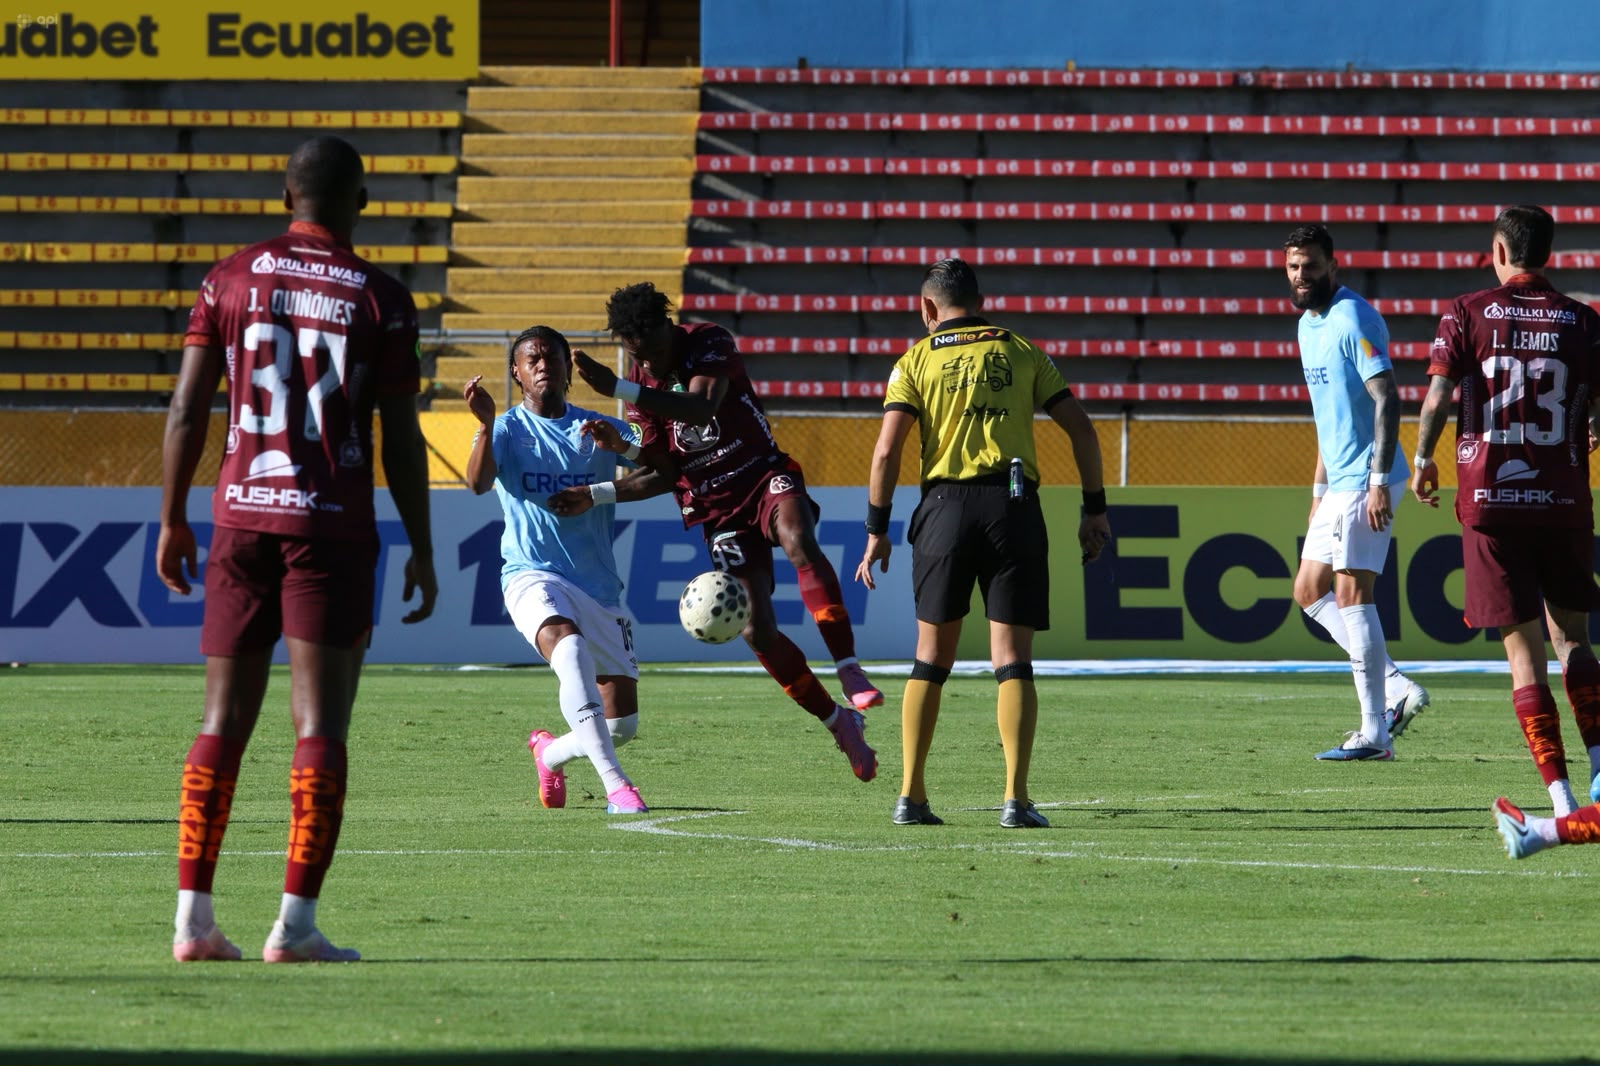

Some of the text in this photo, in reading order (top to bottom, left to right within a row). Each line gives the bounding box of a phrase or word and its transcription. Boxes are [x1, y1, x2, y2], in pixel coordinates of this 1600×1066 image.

[207, 13, 454, 58] Ecuabet
[715, 69, 738, 81] 01
[830, 70, 855, 83] 03
[887, 71, 910, 83] 04
[1007, 70, 1029, 84] 06
[1062, 71, 1085, 84] 07
[1116, 72, 1140, 84] 08
[1176, 72, 1199, 84] 09
[1306, 75, 1324, 86] 11
[1352, 72, 1372, 86] 12
[1412, 74, 1432, 87] 13
[1466, 75, 1485, 87] 14
[1525, 75, 1544, 87] 15
[1579, 75, 1600, 88] 16
[248, 112, 270, 123] 30
[315, 113, 331, 124] 31
[372, 113, 392, 124] 32
[422, 113, 443, 125] 33
[714, 114, 735, 126] 01
[770, 114, 792, 127] 02
[826, 117, 848, 129] 03
[880, 115, 903, 129] 04
[938, 116, 961, 128] 05
[996, 116, 1020, 129] 06
[1053, 116, 1075, 129] 07
[1165, 116, 1188, 130] 09
[1228, 117, 1244, 130] 10
[1284, 117, 1303, 129] 11
[1344, 117, 1363, 130] 12
[1401, 118, 1420, 130] 13
[1456, 118, 1475, 131] 14
[1515, 118, 1535, 131] 15
[1572, 119, 1591, 132] 16
[408, 159, 425, 170] 32
[710, 158, 1594, 178] 01 02 03 04 05 06 07 08 09 10 11 12 13 14 15 16
[708, 201, 1594, 221] 01 02 03 04 05 06 07 08 09 10 11 12 13 14 16
[703, 247, 1594, 267] 01 02 03 04 06 07 08 09 10 13 14 16
[277, 257, 325, 275] KULLKI
[328, 264, 367, 284] WASI
[248, 286, 356, 325] J. QUIÑÓNES
[696, 296, 1414, 312] 01 02 03 04 06 07 08 09 10 13
[1505, 306, 1544, 318] KULLKI
[1546, 308, 1576, 321] WASI
[753, 339, 775, 351] 02
[814, 340, 836, 352] 03
[868, 340, 890, 352] 04
[1046, 341, 1067, 354] 07
[1101, 341, 1125, 353] 08
[1219, 342, 1236, 355] 10
[1277, 343, 1293, 355] 11
[1394, 344, 1413, 356] 13
[934, 330, 976, 346] Netlife
[1493, 329, 1560, 352] L. LEMOS
[239, 321, 347, 441] 37
[799, 382, 1418, 399] 03 04 08 09 10 11 13
[1481, 355, 1568, 446] 23
[225, 484, 319, 509] PUSHAK
[1474, 489, 1555, 504] PUSHAK
[1333, 512, 1344, 542] 4
